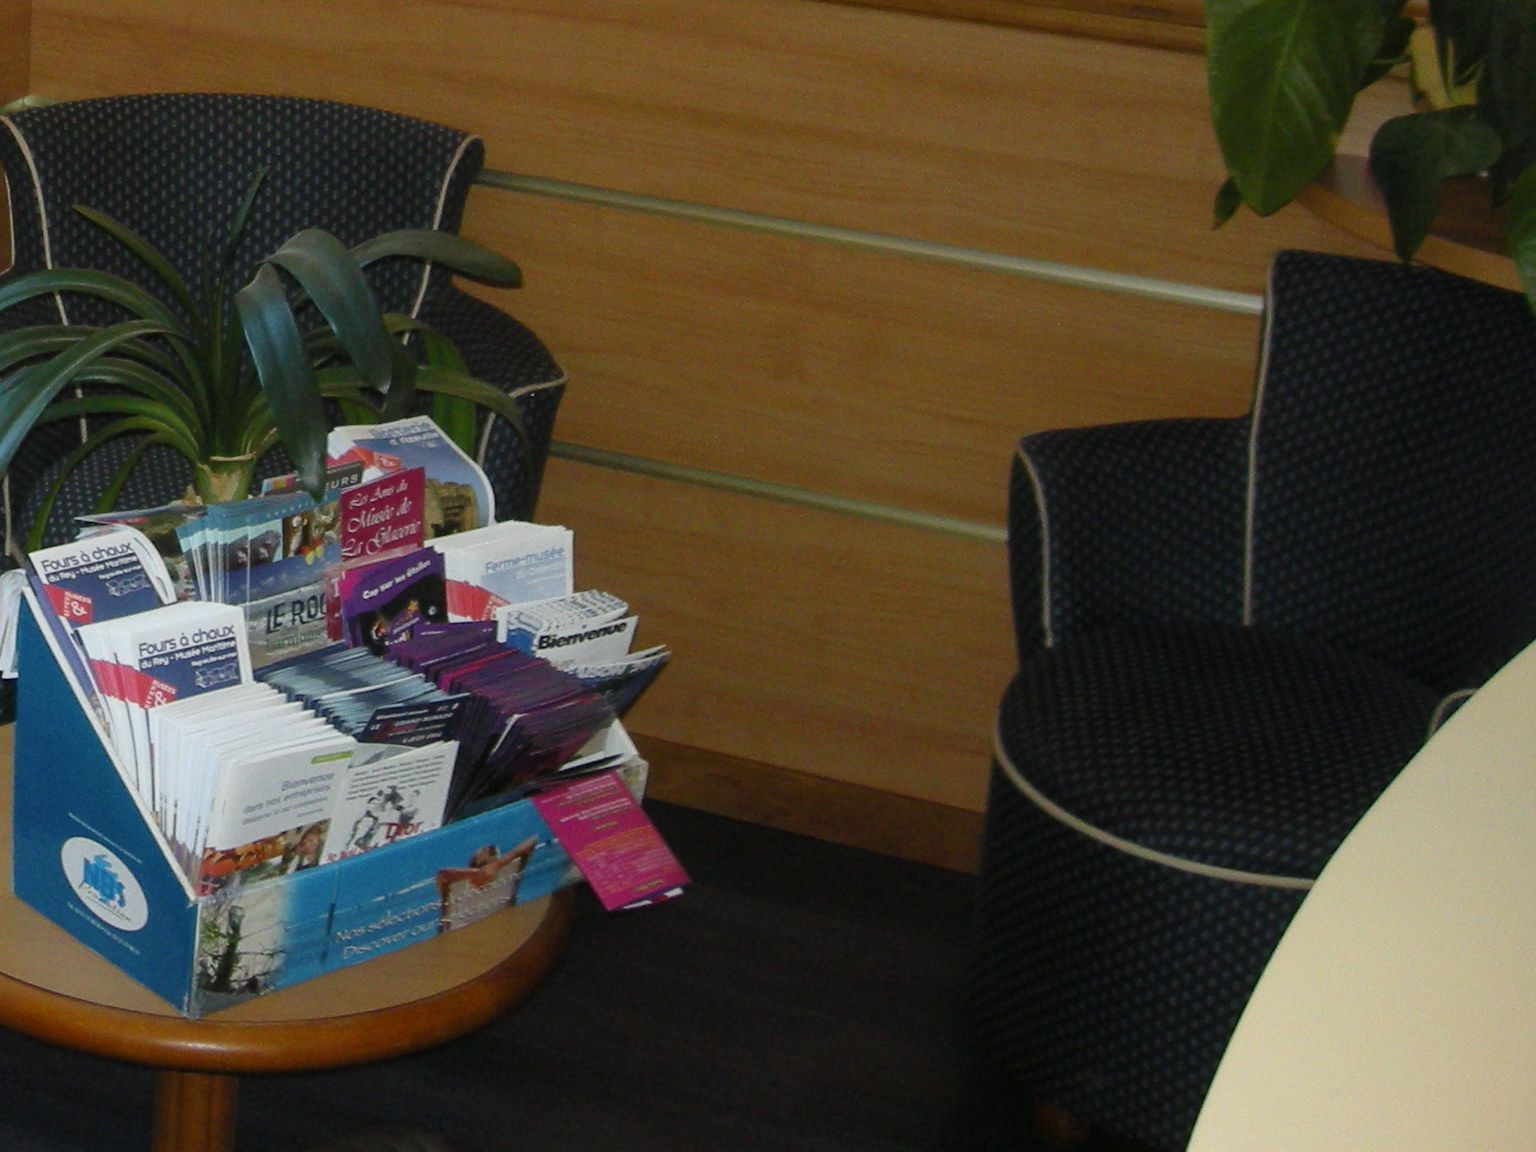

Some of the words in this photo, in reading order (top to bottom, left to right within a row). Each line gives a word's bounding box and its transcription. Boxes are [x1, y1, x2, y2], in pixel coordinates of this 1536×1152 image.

[41, 557, 79, 571] Fours
[80, 551, 88, 563] à
[92, 542, 133, 560] chaux
[363, 588, 379, 600] Cap
[138, 640, 176, 657] Fours
[180, 633, 189, 649] à
[192, 625, 235, 644] chaux
[537, 621, 627, 650] Bienvenue
[141, 659, 152, 669] du
[175, 647, 201, 661] Musée
[202, 639, 236, 654] Maritime
